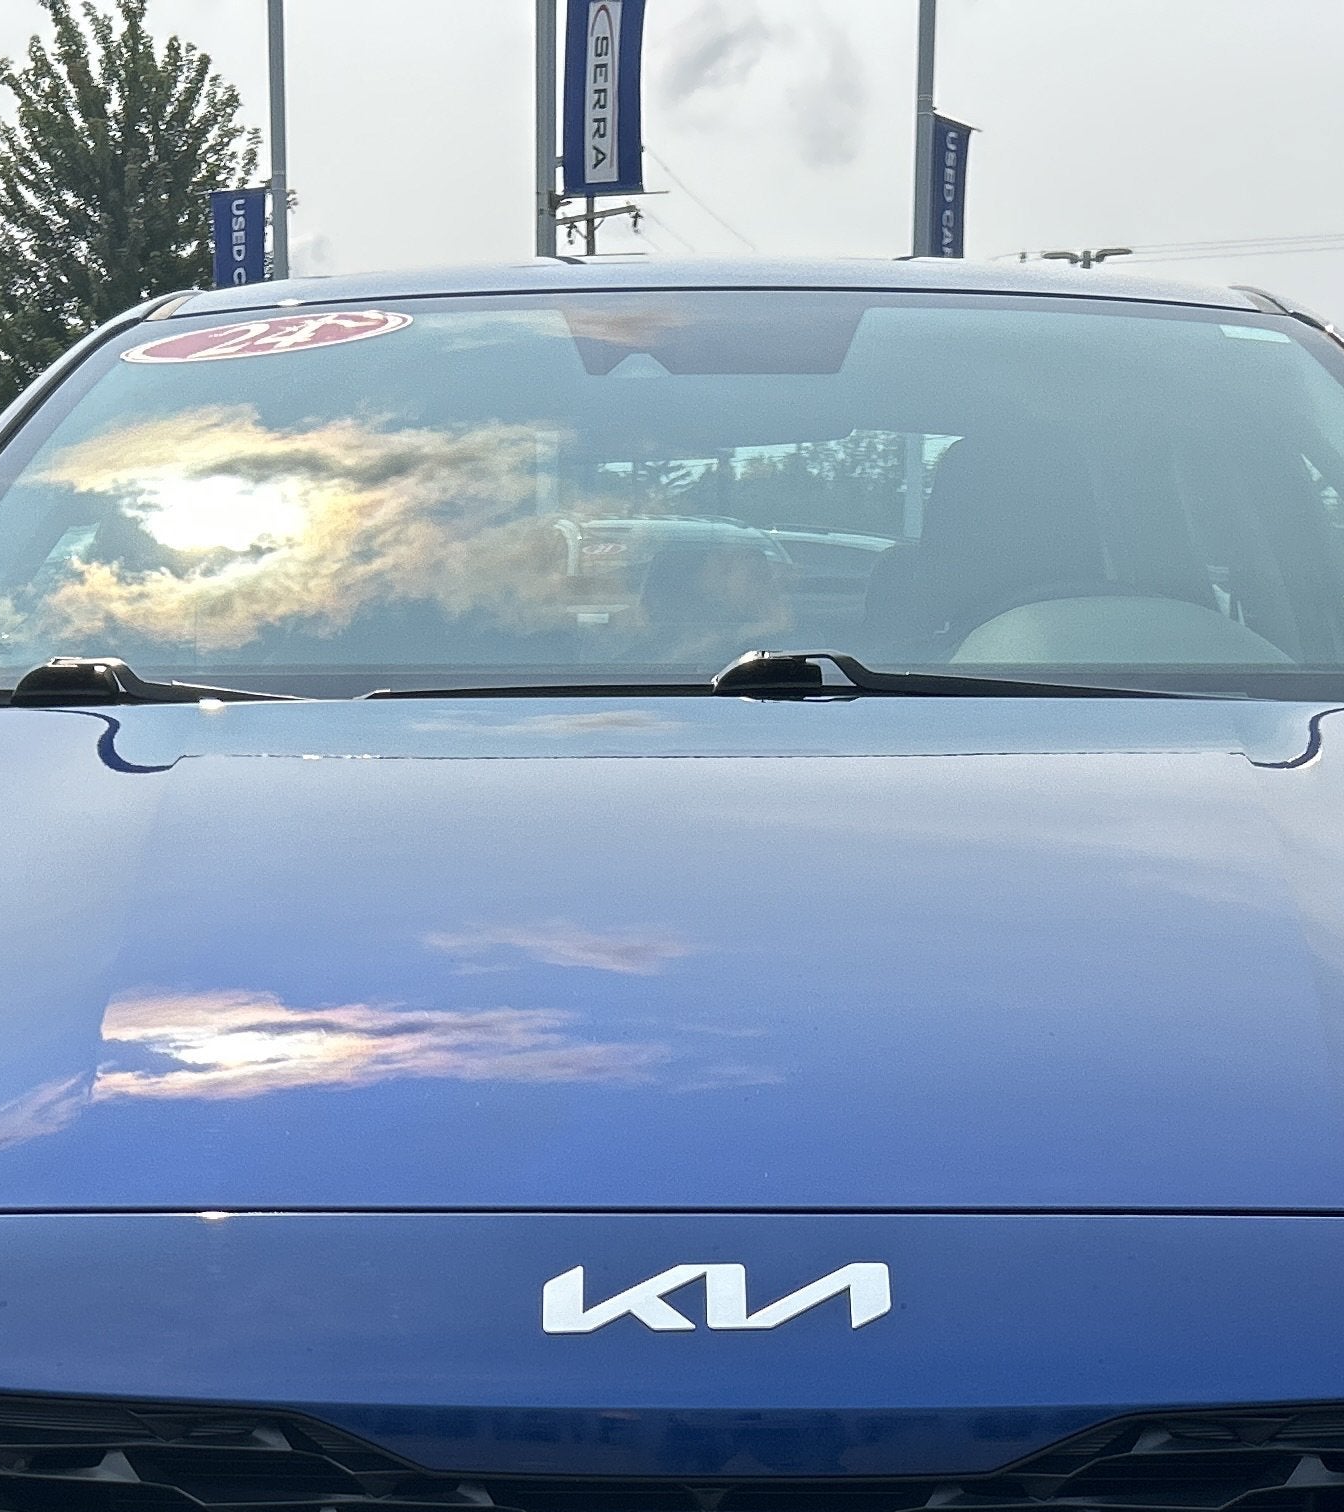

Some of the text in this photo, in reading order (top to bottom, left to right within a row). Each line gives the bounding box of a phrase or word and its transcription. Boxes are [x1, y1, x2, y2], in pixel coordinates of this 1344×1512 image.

[592, 36, 609, 169] SERRA
[943, 131, 958, 203] USED
[231, 199, 246, 262] USED
[543, 1262, 892, 1333] KIA
